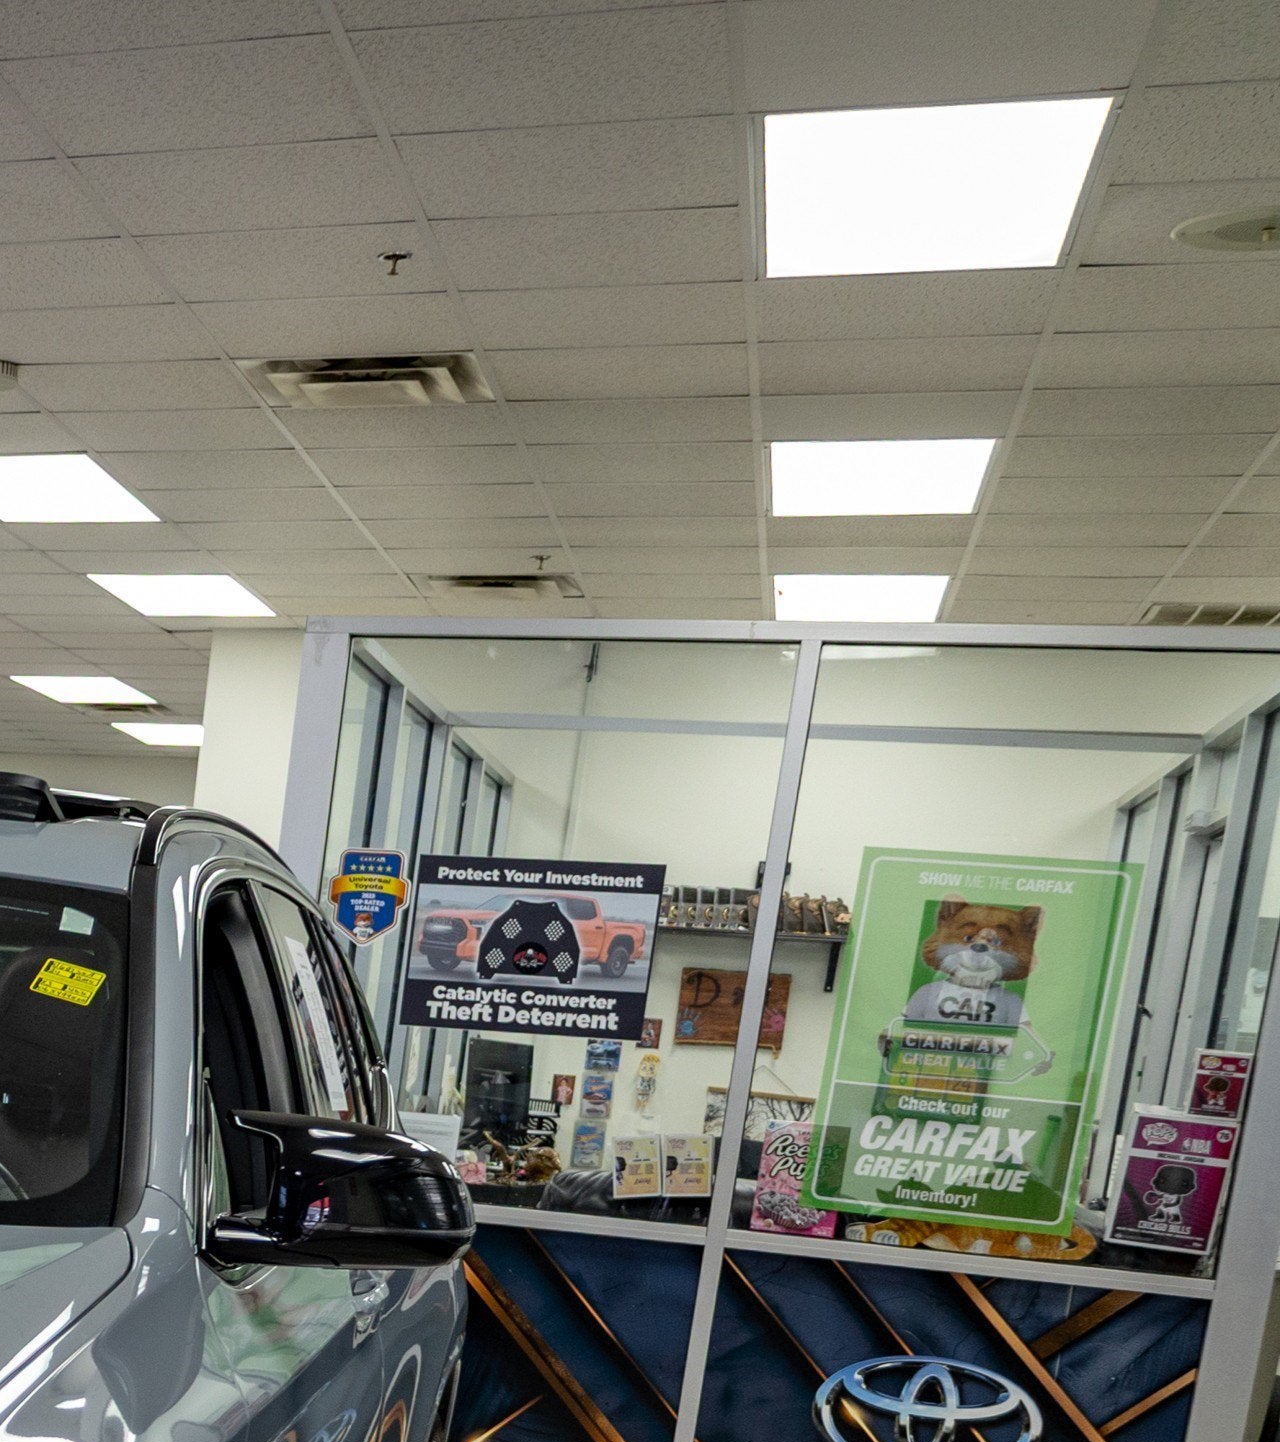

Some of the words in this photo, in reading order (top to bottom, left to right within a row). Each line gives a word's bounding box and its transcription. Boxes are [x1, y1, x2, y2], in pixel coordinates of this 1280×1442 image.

[349, 875, 391, 884] Universal
[354, 882, 384, 890] Toyota
[438, 866, 500, 883] Protect
[504, 868, 542, 884] Your
[545, 871, 644, 888] Investment
[918, 871, 962, 887] SHOW
[965, 874, 985, 889] ME
[989, 876, 1013, 891] THE
[1015, 878, 1076, 895] CARFAX
[350, 898, 385, 908] TOP-RATED
[354, 904, 379, 912] DEALER
[432, 984, 517, 1004] Catalytic
[520, 990, 617, 1010] Converter
[938, 996, 997, 1022] CAR
[426, 1000, 493, 1023] Theft
[497, 1005, 619, 1031] Deterrent
[904, 1033, 1009, 1057] CARFAX
[901, 1052, 952, 1068] GREAT
[956, 1056, 1007, 1072] VALUE
[898, 1095, 947, 1114] Check
[952, 1102, 979, 1117] out
[981, 1105, 1010, 1119] our
[859, 1114, 1037, 1165] CARFAX
[1190, 1138, 1212, 1154] NBA
[853, 1153, 942, 1184] GREAT
[943, 1162, 1031, 1193] VALUE
[895, 1184, 978, 1209] Inventory!
